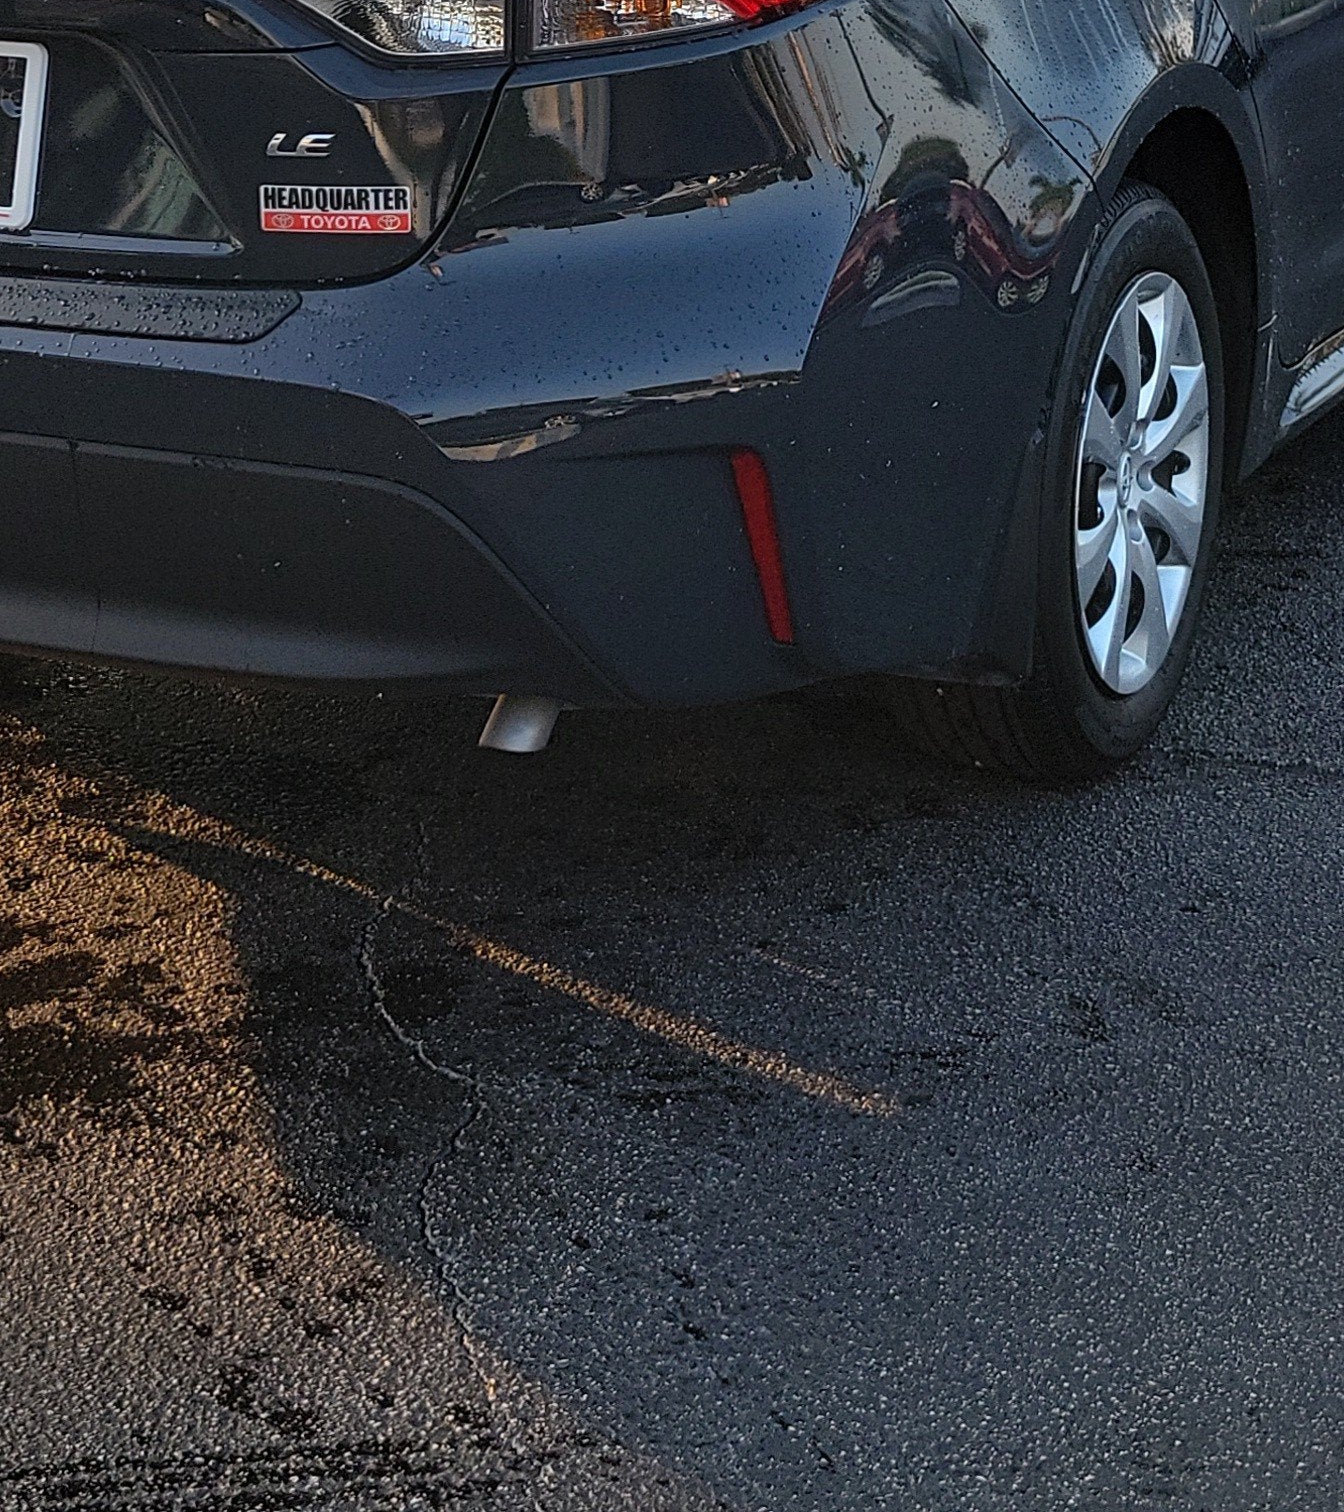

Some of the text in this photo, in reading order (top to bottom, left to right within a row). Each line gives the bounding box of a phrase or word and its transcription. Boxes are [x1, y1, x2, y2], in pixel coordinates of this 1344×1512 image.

[266, 133, 336, 156] LE
[263, 187, 409, 212] HEADQUARTER
[300, 215, 372, 229] TOYOTA
